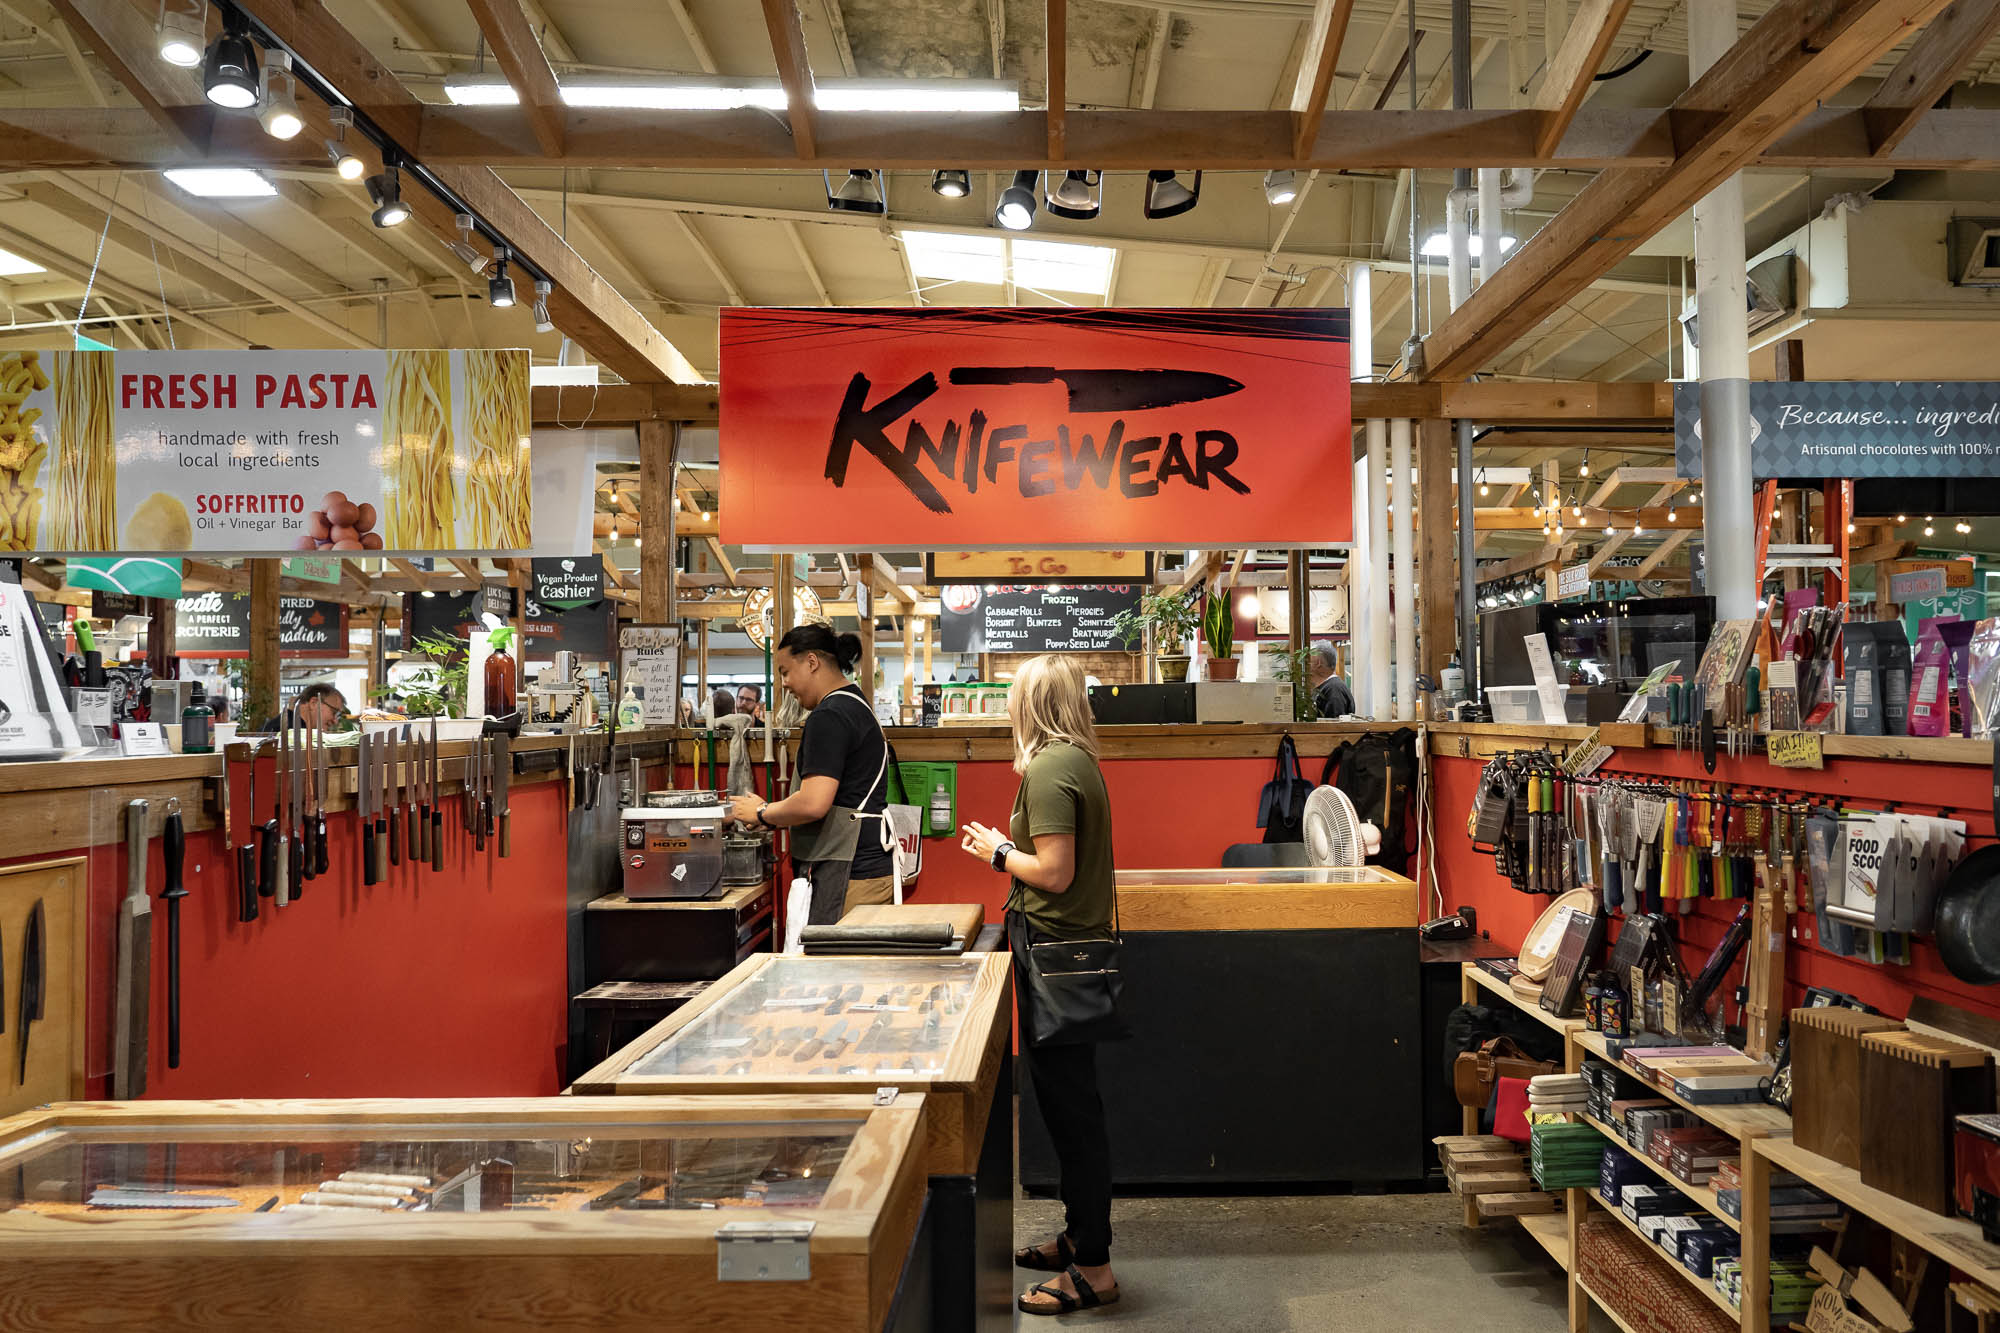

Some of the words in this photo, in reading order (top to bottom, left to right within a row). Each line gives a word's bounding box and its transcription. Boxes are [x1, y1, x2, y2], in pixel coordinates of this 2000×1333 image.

[121, 374, 237, 409] FRESH
[256, 373, 377, 409] PASTA
[1776, 404, 1908, 429] Because...
[158, 430, 246, 446] handmade
[255, 430, 288, 446] with
[298, 430, 339, 446] fresh
[824, 370, 1251, 515] KNIFEWEAR
[1801, 443, 1857, 456] Artisanal
[1860, 443, 1928, 456] chocolates
[1930, 443, 1956, 456] with
[1959, 443, 1993, 456] 100%
[179, 452, 218, 467] local
[228, 452, 319, 471] ingredients
[196, 494, 304, 514] SOFFRITTO
[196, 517, 214, 529] Oil
[229, 517, 276, 531] Vinegar
[282, 517, 303, 529] Bar
[537, 574, 562, 585] Vegan
[564, 573, 598, 582] Product
[540, 584, 595, 599] Cashier
[176, 591, 224, 612] reate
[280, 598, 315, 608] PIRED
[1041, 594, 1079, 605] FROZEN
[188, 615, 194, 623] A
[197, 615, 230, 623] PERFECT
[985, 606, 1019, 617] CABBAGE
[1019, 606, 1042, 616] ROLLS
[1066, 606, 1104, 616] PIEROGIES
[1027, 617, 1062, 627] BLINTZES
[176, 626, 241, 638] RCUTERIE
[280, 626, 328, 643] nadian
[985, 628, 1029, 639] MEATBALLS
[1072, 628, 1113, 638] BRATWURS
[1045, 639, 1069, 649] POPPY
[1069, 639, 1089, 649] SEED
[1091, 639, 1110, 649] LOAF
[898, 834, 918, 854] all
[1849, 839, 1879, 854] FOOD
[1852, 854, 1882, 870] SCOO
